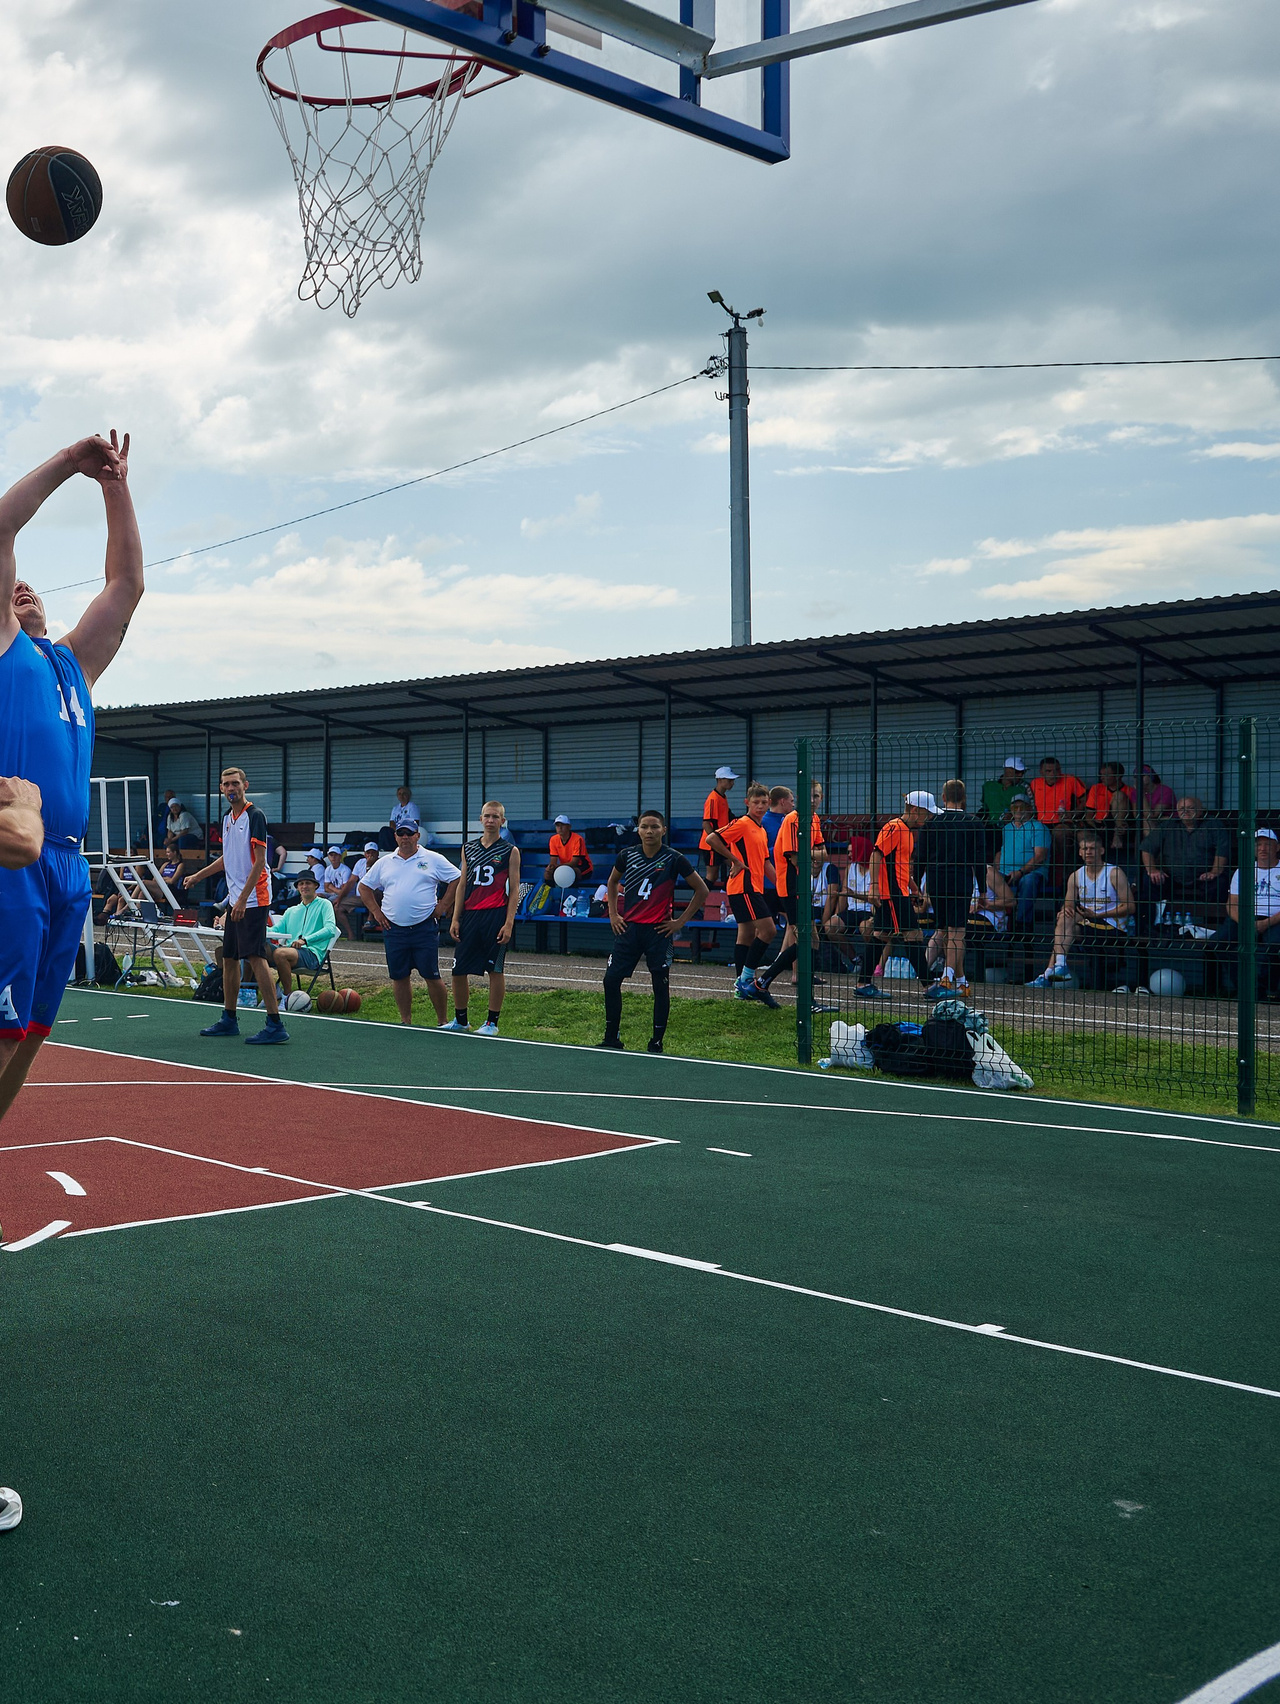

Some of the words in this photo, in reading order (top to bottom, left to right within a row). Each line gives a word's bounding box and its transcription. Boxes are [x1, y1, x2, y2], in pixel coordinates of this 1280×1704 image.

[56, 683, 86, 728] 14
[473, 865, 495, 886] 13
[637, 878, 653, 900] 4
